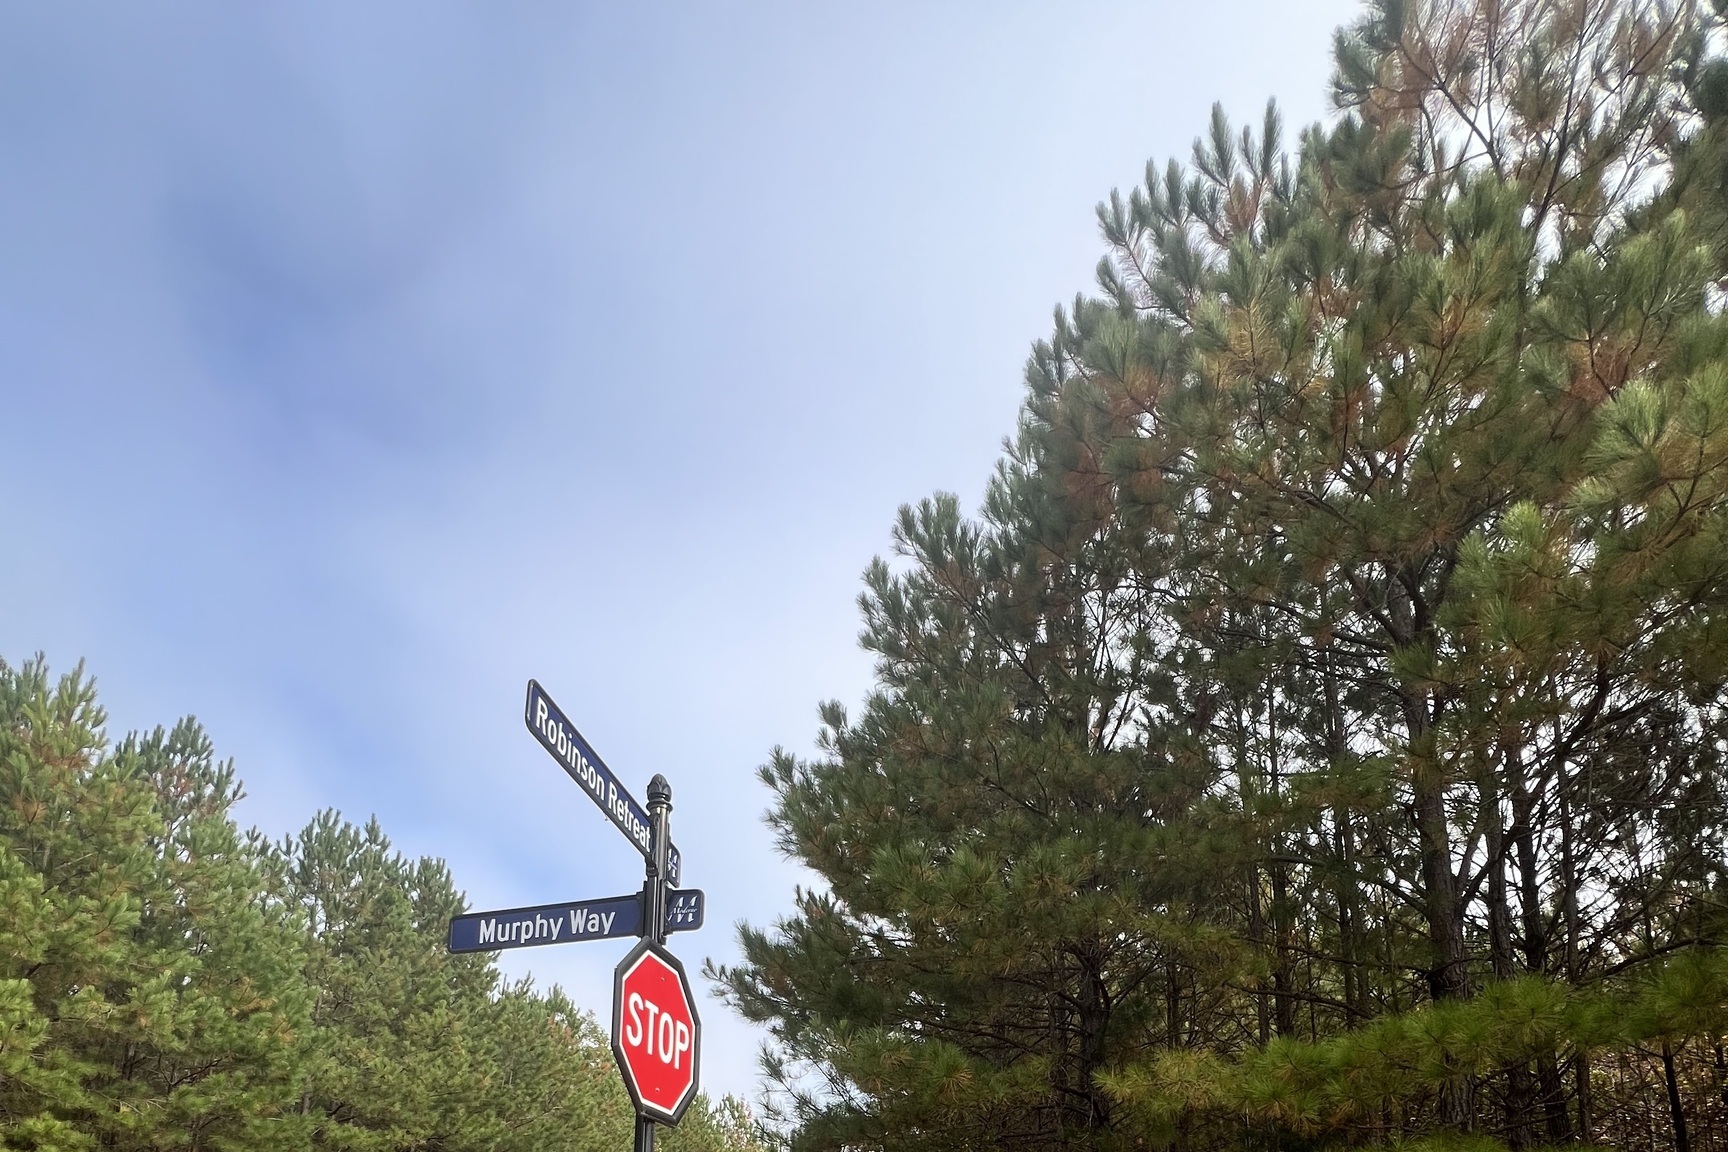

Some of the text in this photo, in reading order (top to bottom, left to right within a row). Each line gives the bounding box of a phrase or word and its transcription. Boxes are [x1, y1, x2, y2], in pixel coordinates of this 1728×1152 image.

[535, 696, 651, 852] Robinson Retreat
[479, 908, 615, 944] Murphy Way
[626, 992, 689, 1069] STOP
